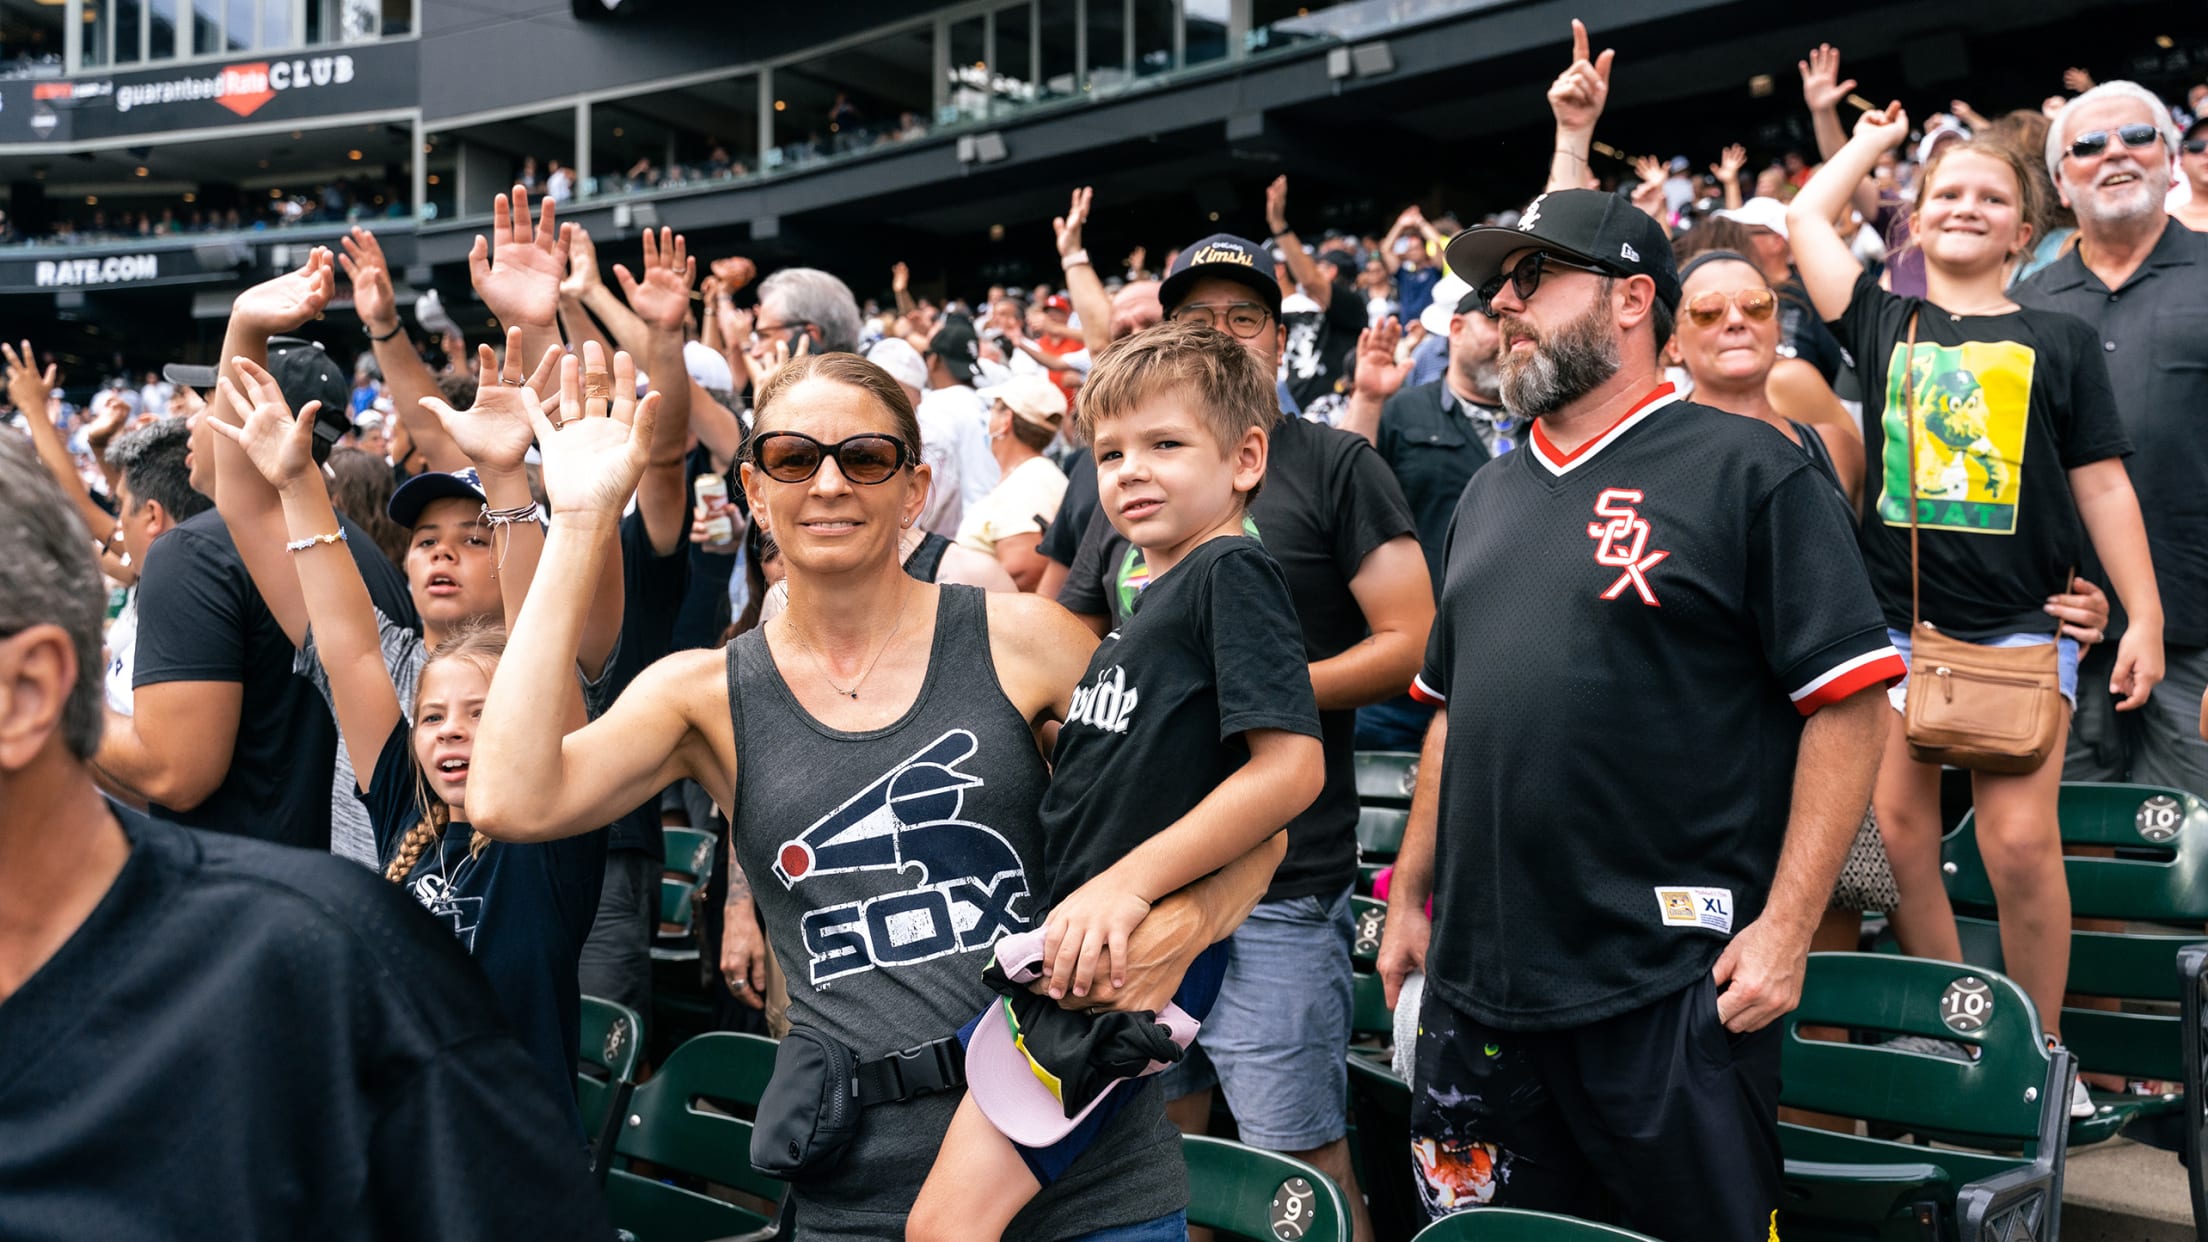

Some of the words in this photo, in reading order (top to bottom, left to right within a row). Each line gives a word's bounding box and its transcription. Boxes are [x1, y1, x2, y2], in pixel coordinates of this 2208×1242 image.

[116, 75, 223, 112] guaranteed
[269, 55, 355, 90] CLUB
[1190, 246, 1254, 267] Kimski
[36, 254, 158, 287] RATE.COM
[1886, 500, 1997, 528] GOAT
[1586, 487, 1671, 607] SOX
[2143, 808, 2175, 828] 10
[1702, 897, 1728, 916] XL
[801, 869, 1031, 986] SOX
[1363, 920, 1378, 939] 8
[1950, 991, 1985, 1015] 10
[1284, 1196, 1302, 1221] 9
